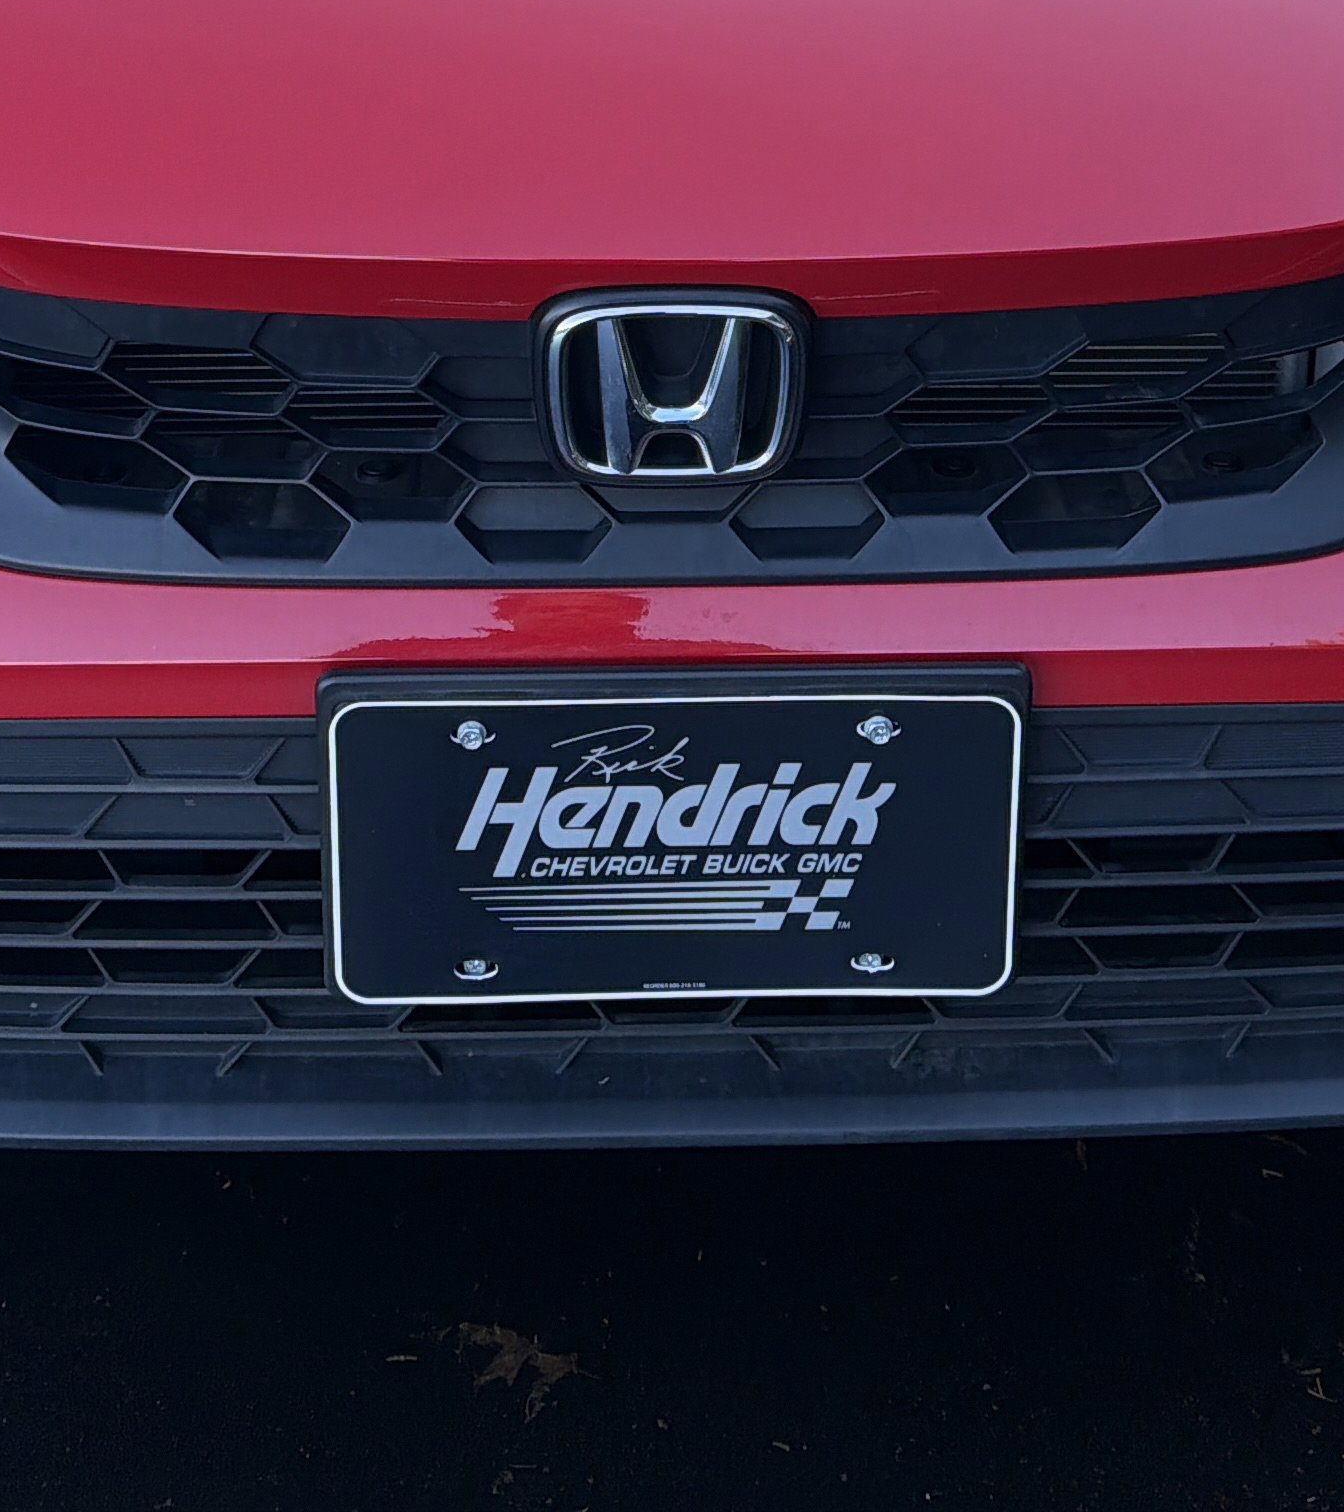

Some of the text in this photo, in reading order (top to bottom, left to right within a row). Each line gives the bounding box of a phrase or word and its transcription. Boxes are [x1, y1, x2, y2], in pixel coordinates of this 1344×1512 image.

[455, 762, 897, 878] Hendrick
[529, 852, 863, 878] CHEVROLET BUICK GMC
